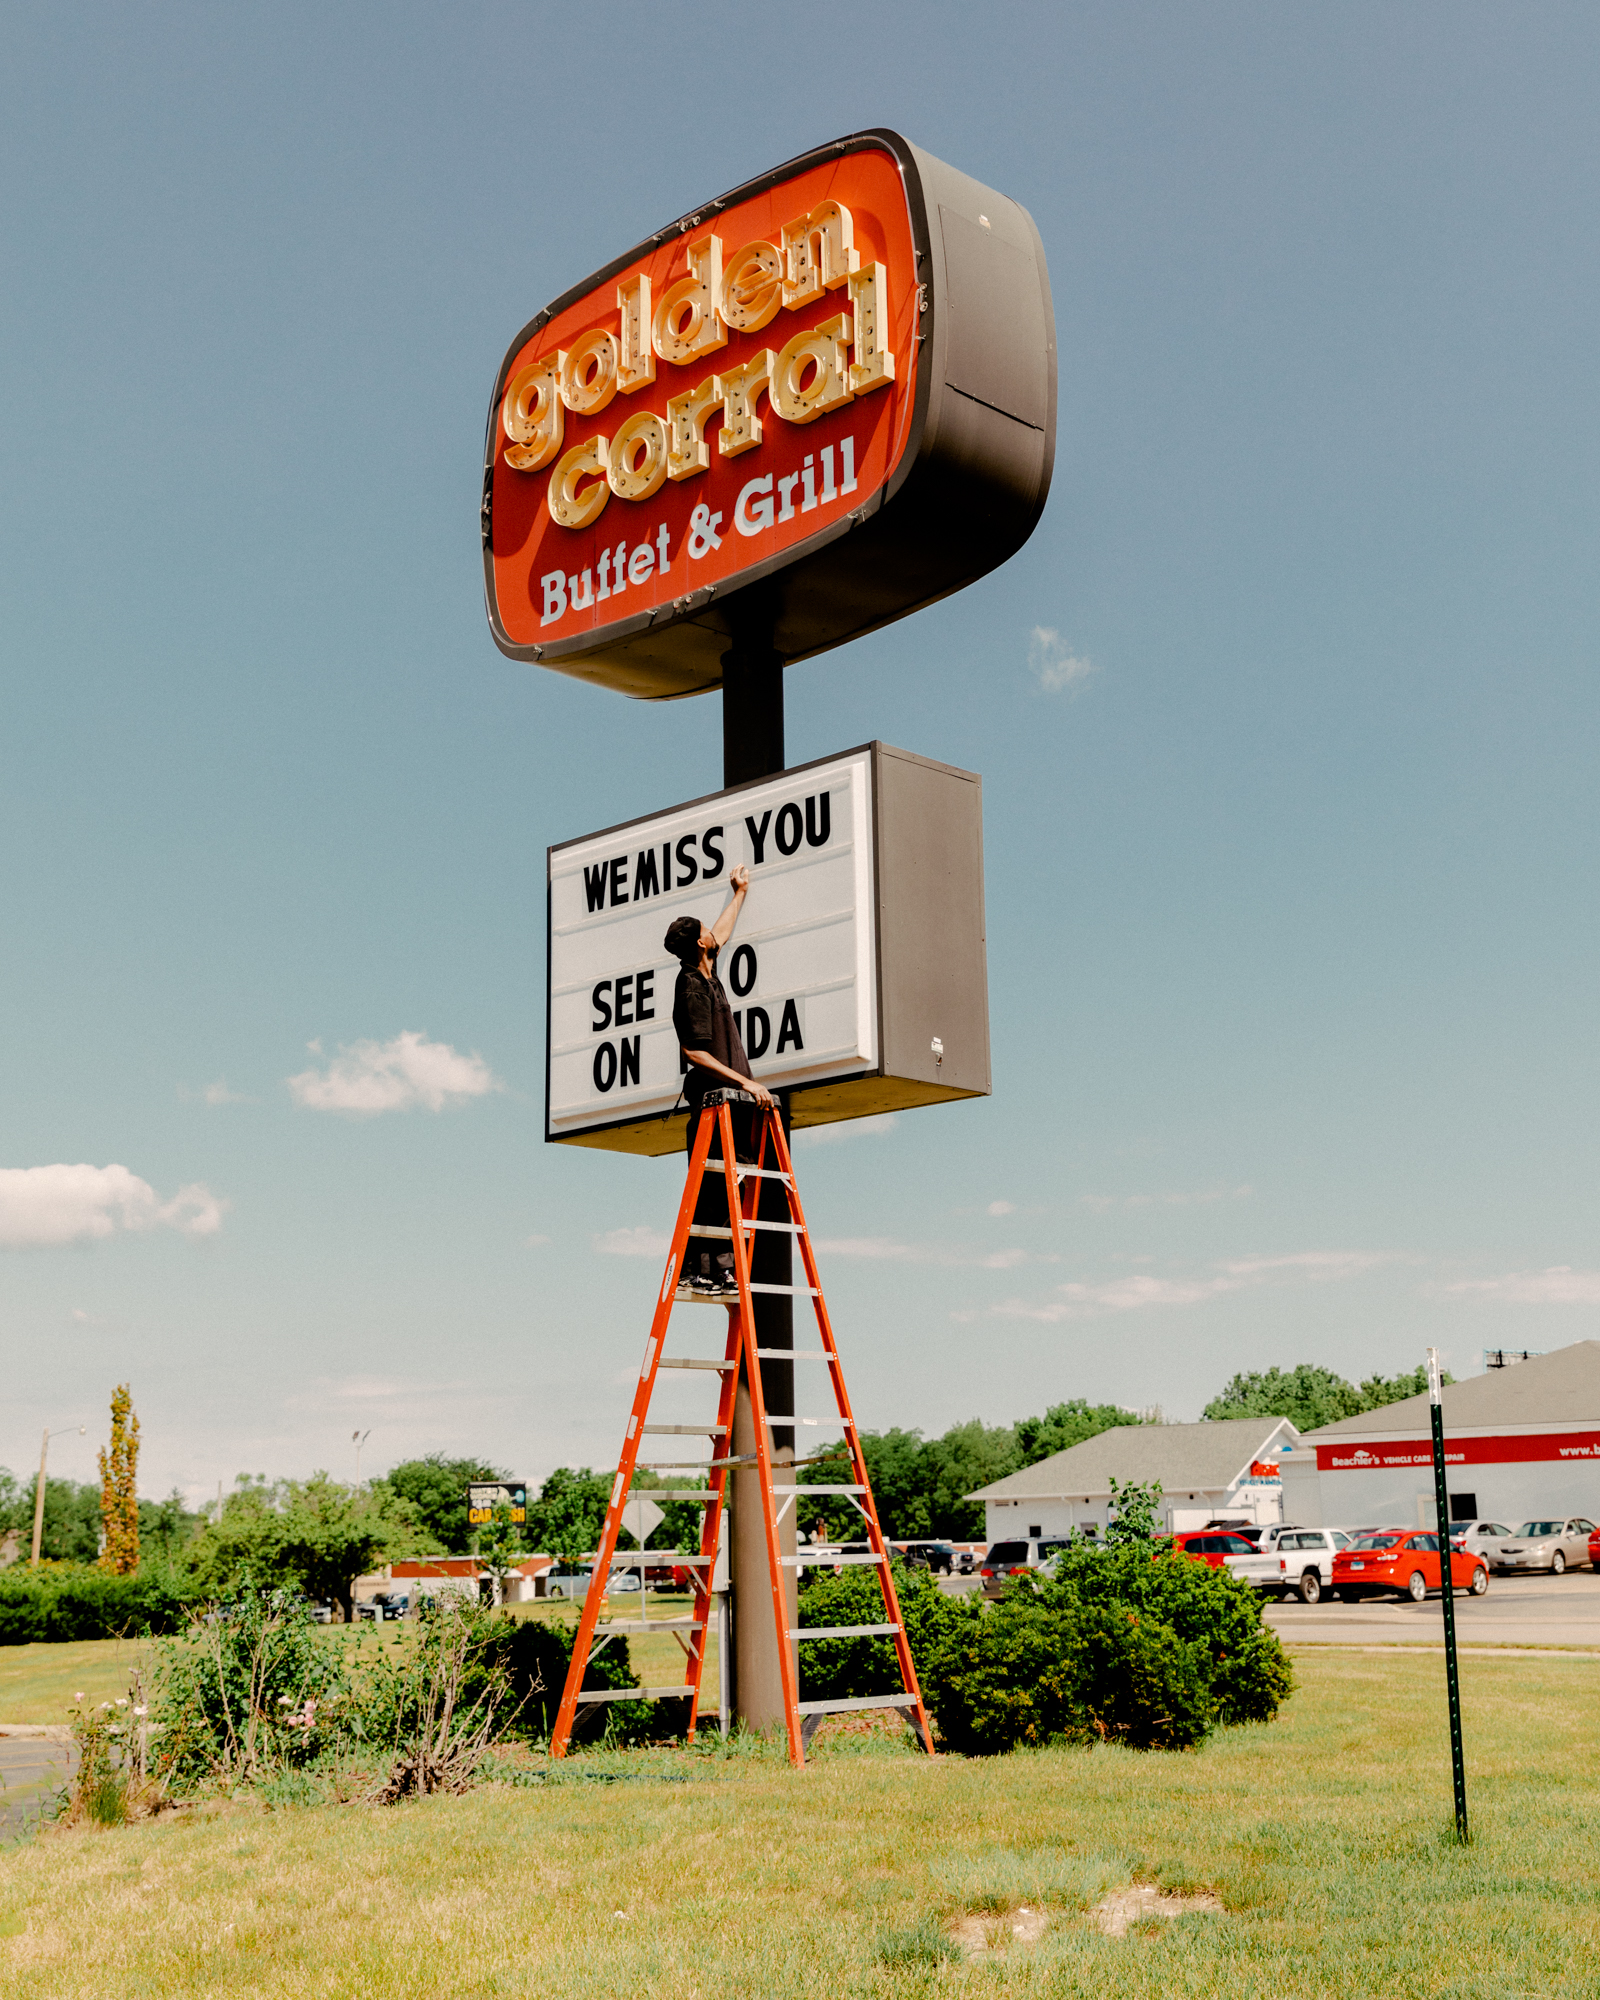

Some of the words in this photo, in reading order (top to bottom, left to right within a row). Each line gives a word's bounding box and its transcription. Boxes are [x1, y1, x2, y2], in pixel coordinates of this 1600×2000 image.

[503, 200, 860, 472] golden
[548, 261, 895, 529] corral
[539, 522, 671, 627] Buffet
[688, 503, 722, 560] &
[734, 435, 858, 536] Grill
[745, 791, 831, 864] YOU
[592, 969, 655, 1032] SEE
[592, 1034, 641, 1093] ON
[1383, 1455, 1412, 1464] VEHICLE
[1413, 1454, 1431, 1463] CARE
[1444, 1453, 1465, 1462] EPAIR
[468, 1507, 492, 1524] CAR
